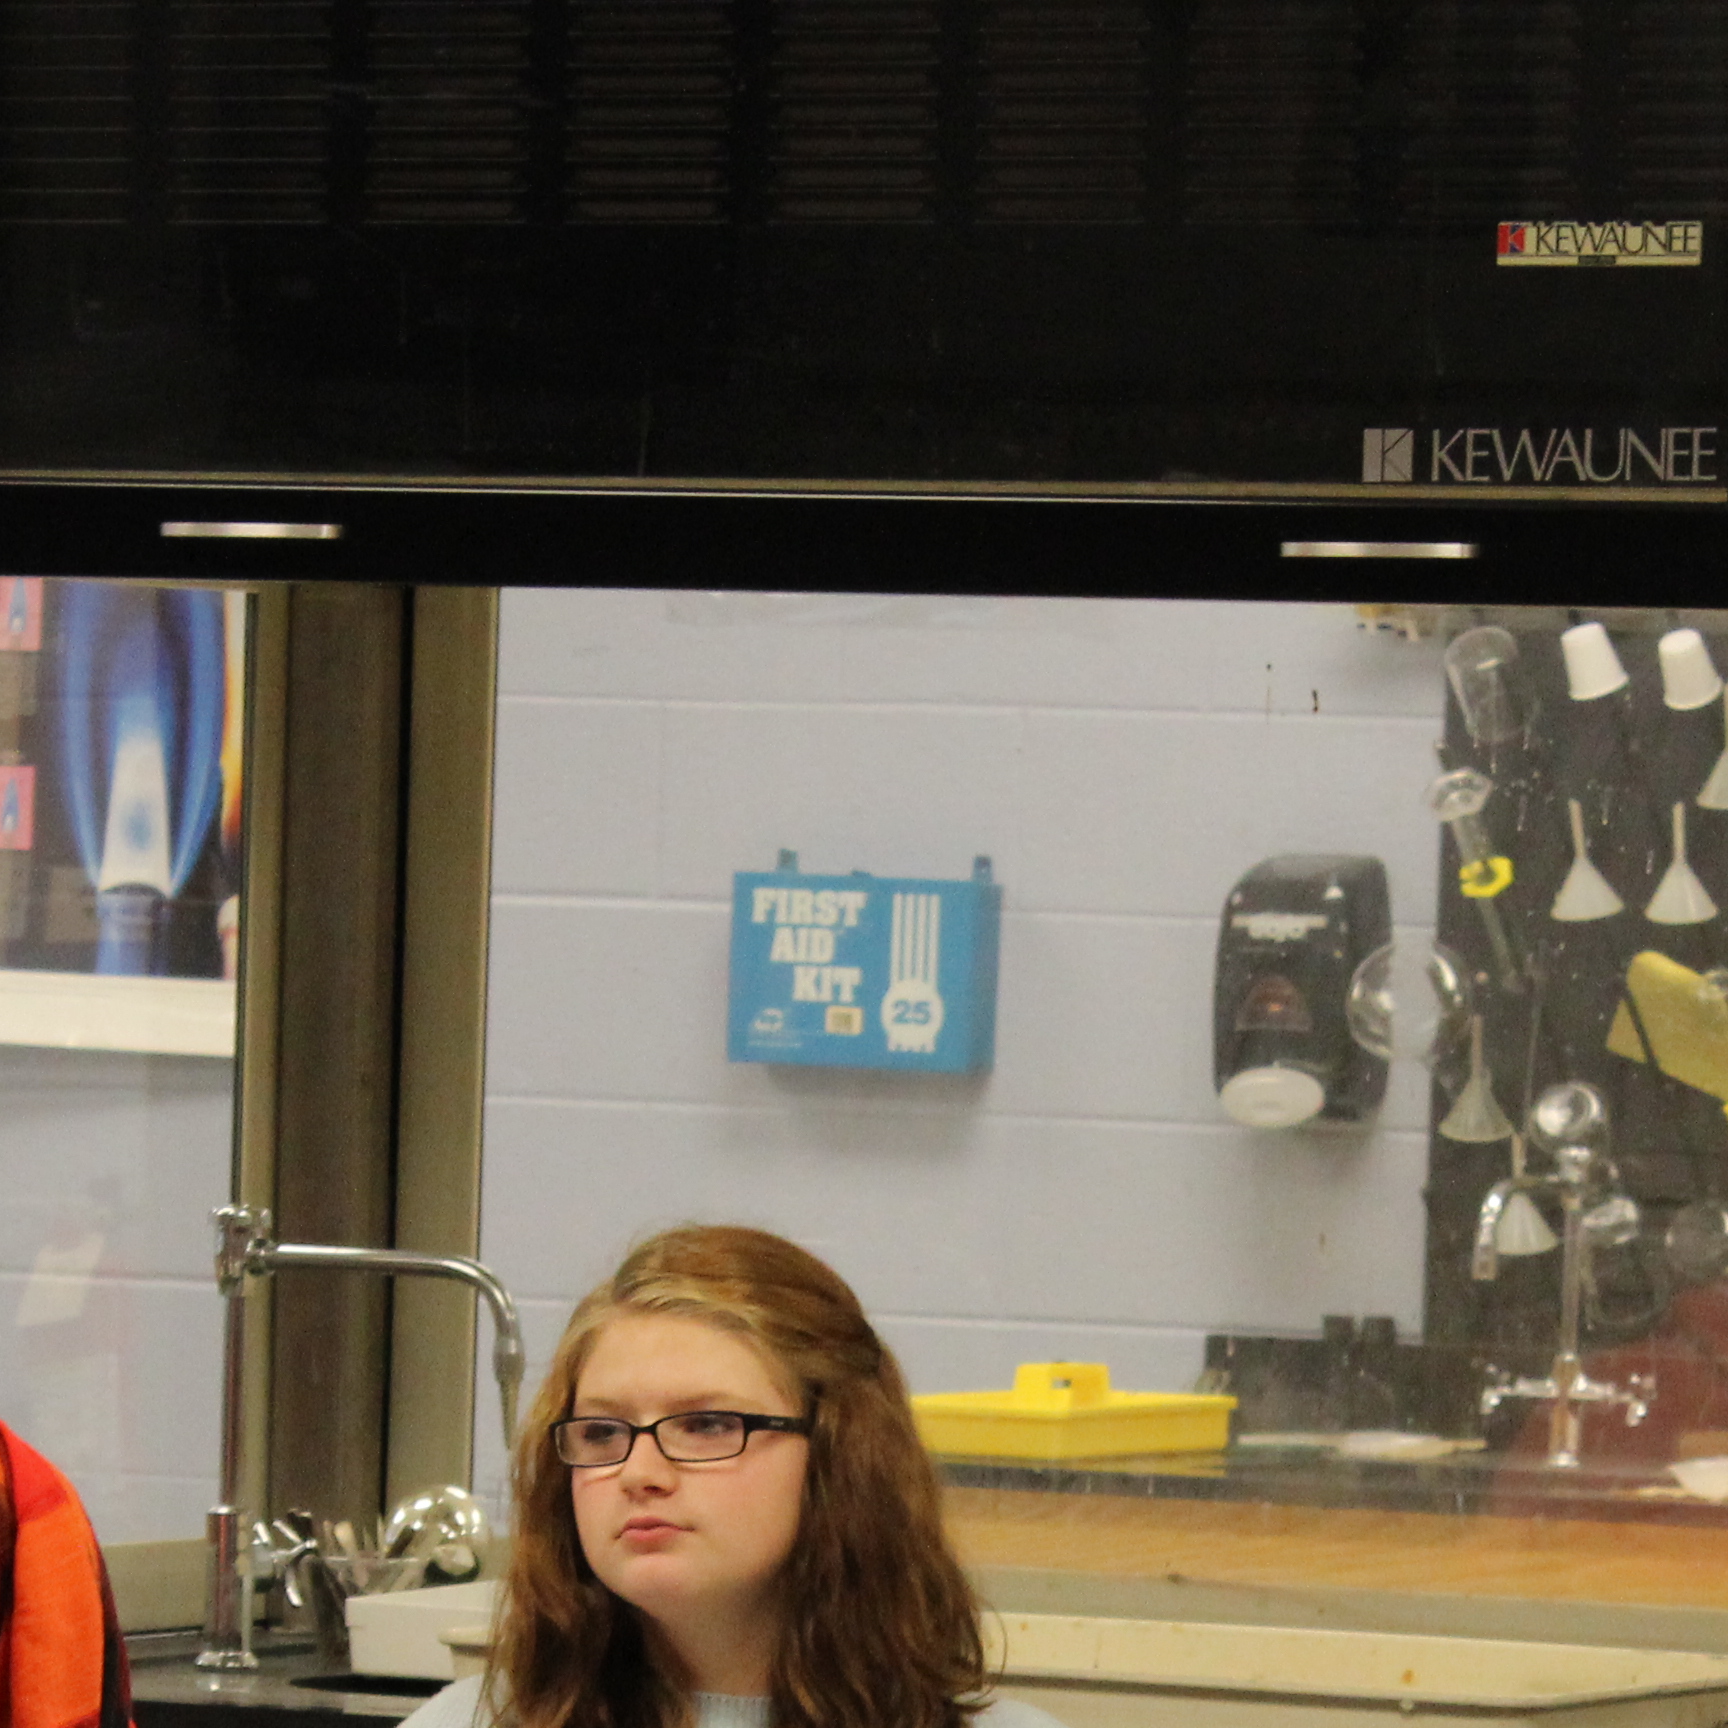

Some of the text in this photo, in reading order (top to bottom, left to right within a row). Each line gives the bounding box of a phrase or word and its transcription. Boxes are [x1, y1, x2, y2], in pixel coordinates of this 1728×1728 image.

[1535, 223, 1702, 255] KEWAUNEE
[1431, 427, 1718, 483] KEWAUNEE
[752, 888, 868, 926] FIRST
[770, 926, 836, 964] AID
[793, 966, 861, 1002] KIT
[891, 999, 932, 1026] 25
